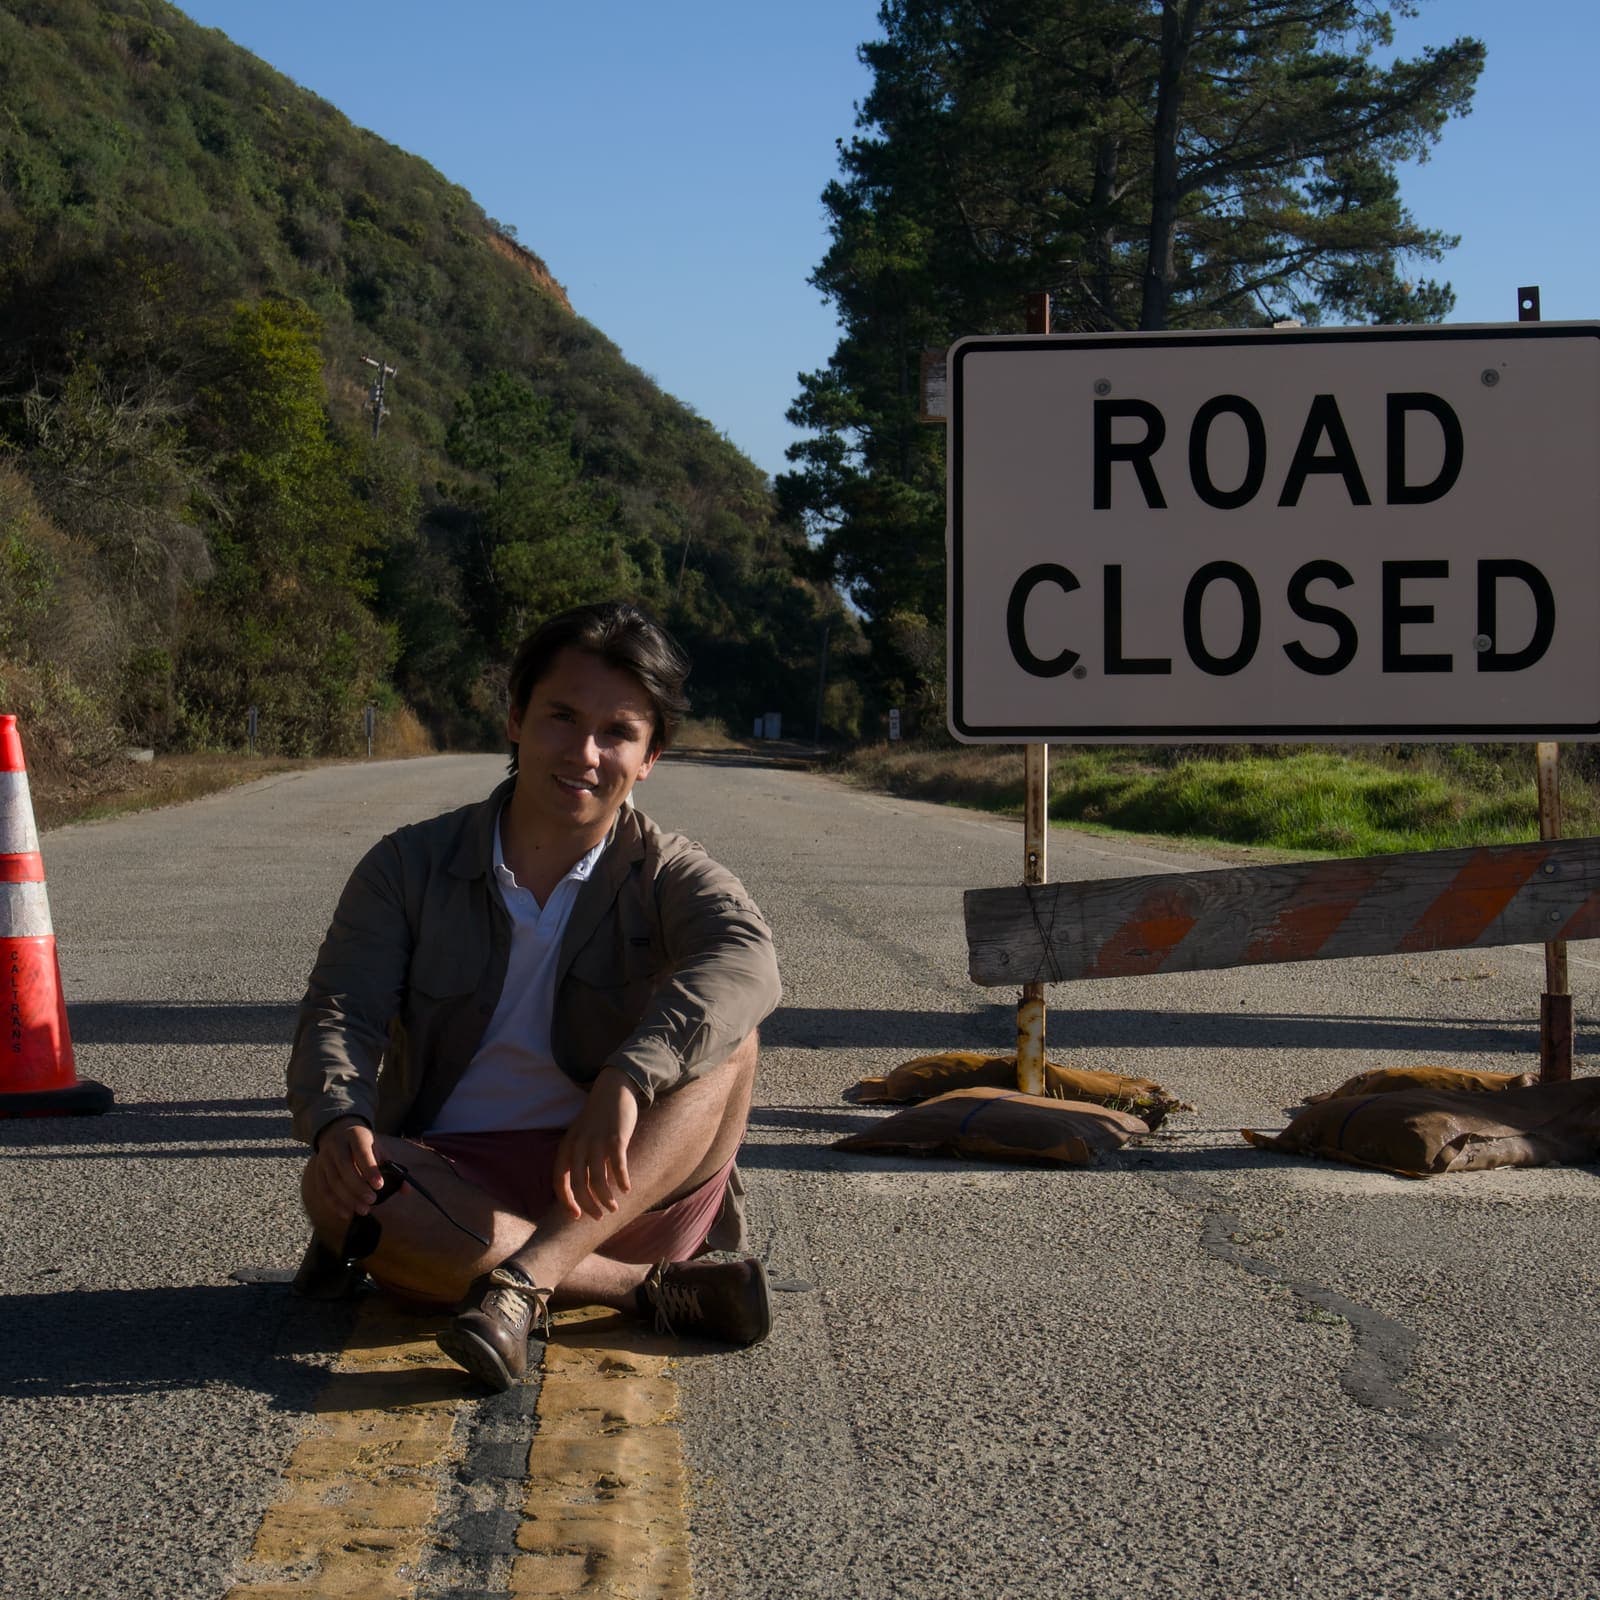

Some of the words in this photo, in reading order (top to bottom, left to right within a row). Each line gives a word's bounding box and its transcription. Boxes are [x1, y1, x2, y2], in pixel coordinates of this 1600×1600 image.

[1093, 392, 1465, 511] ROAD
[1006, 558, 1556, 679] CLOSED
[10, 951, 21, 1053] CALTRANS
